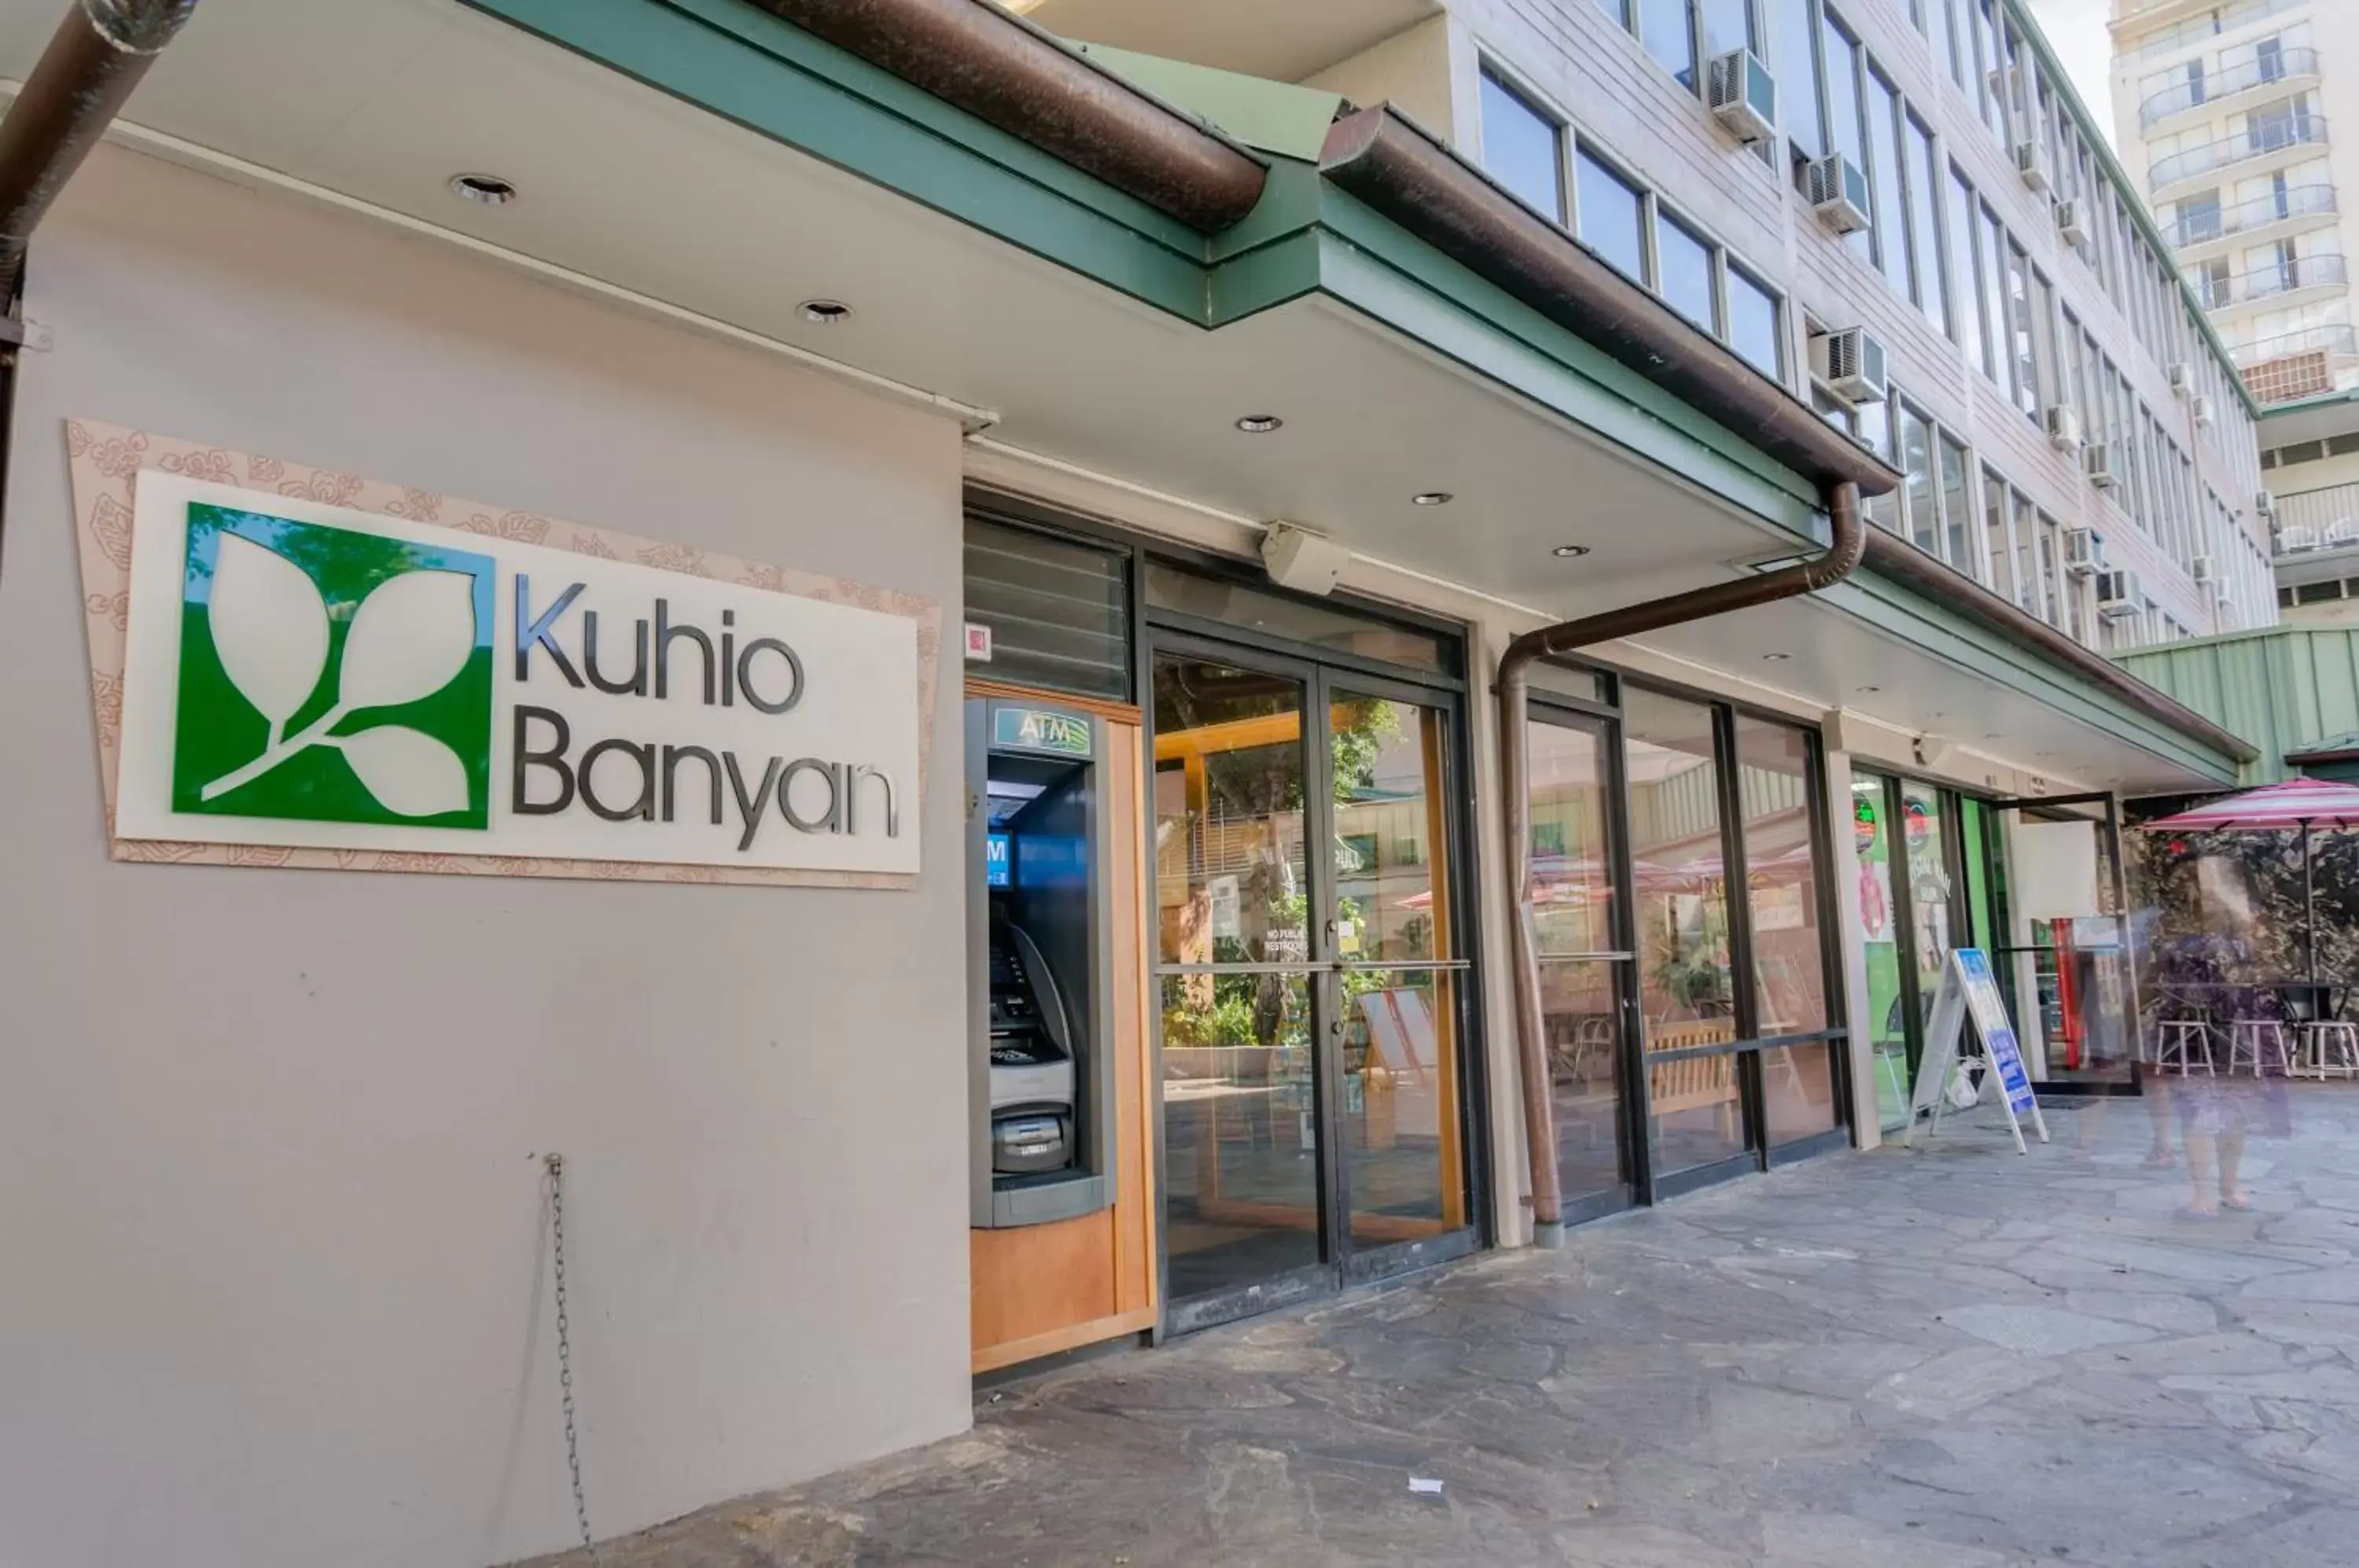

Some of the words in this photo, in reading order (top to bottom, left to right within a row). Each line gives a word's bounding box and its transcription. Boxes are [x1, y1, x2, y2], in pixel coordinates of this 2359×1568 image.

[515, 573, 804, 715] Kuhio
[512, 705, 899, 852] Banyan
[1019, 712, 1071, 743] ATM
